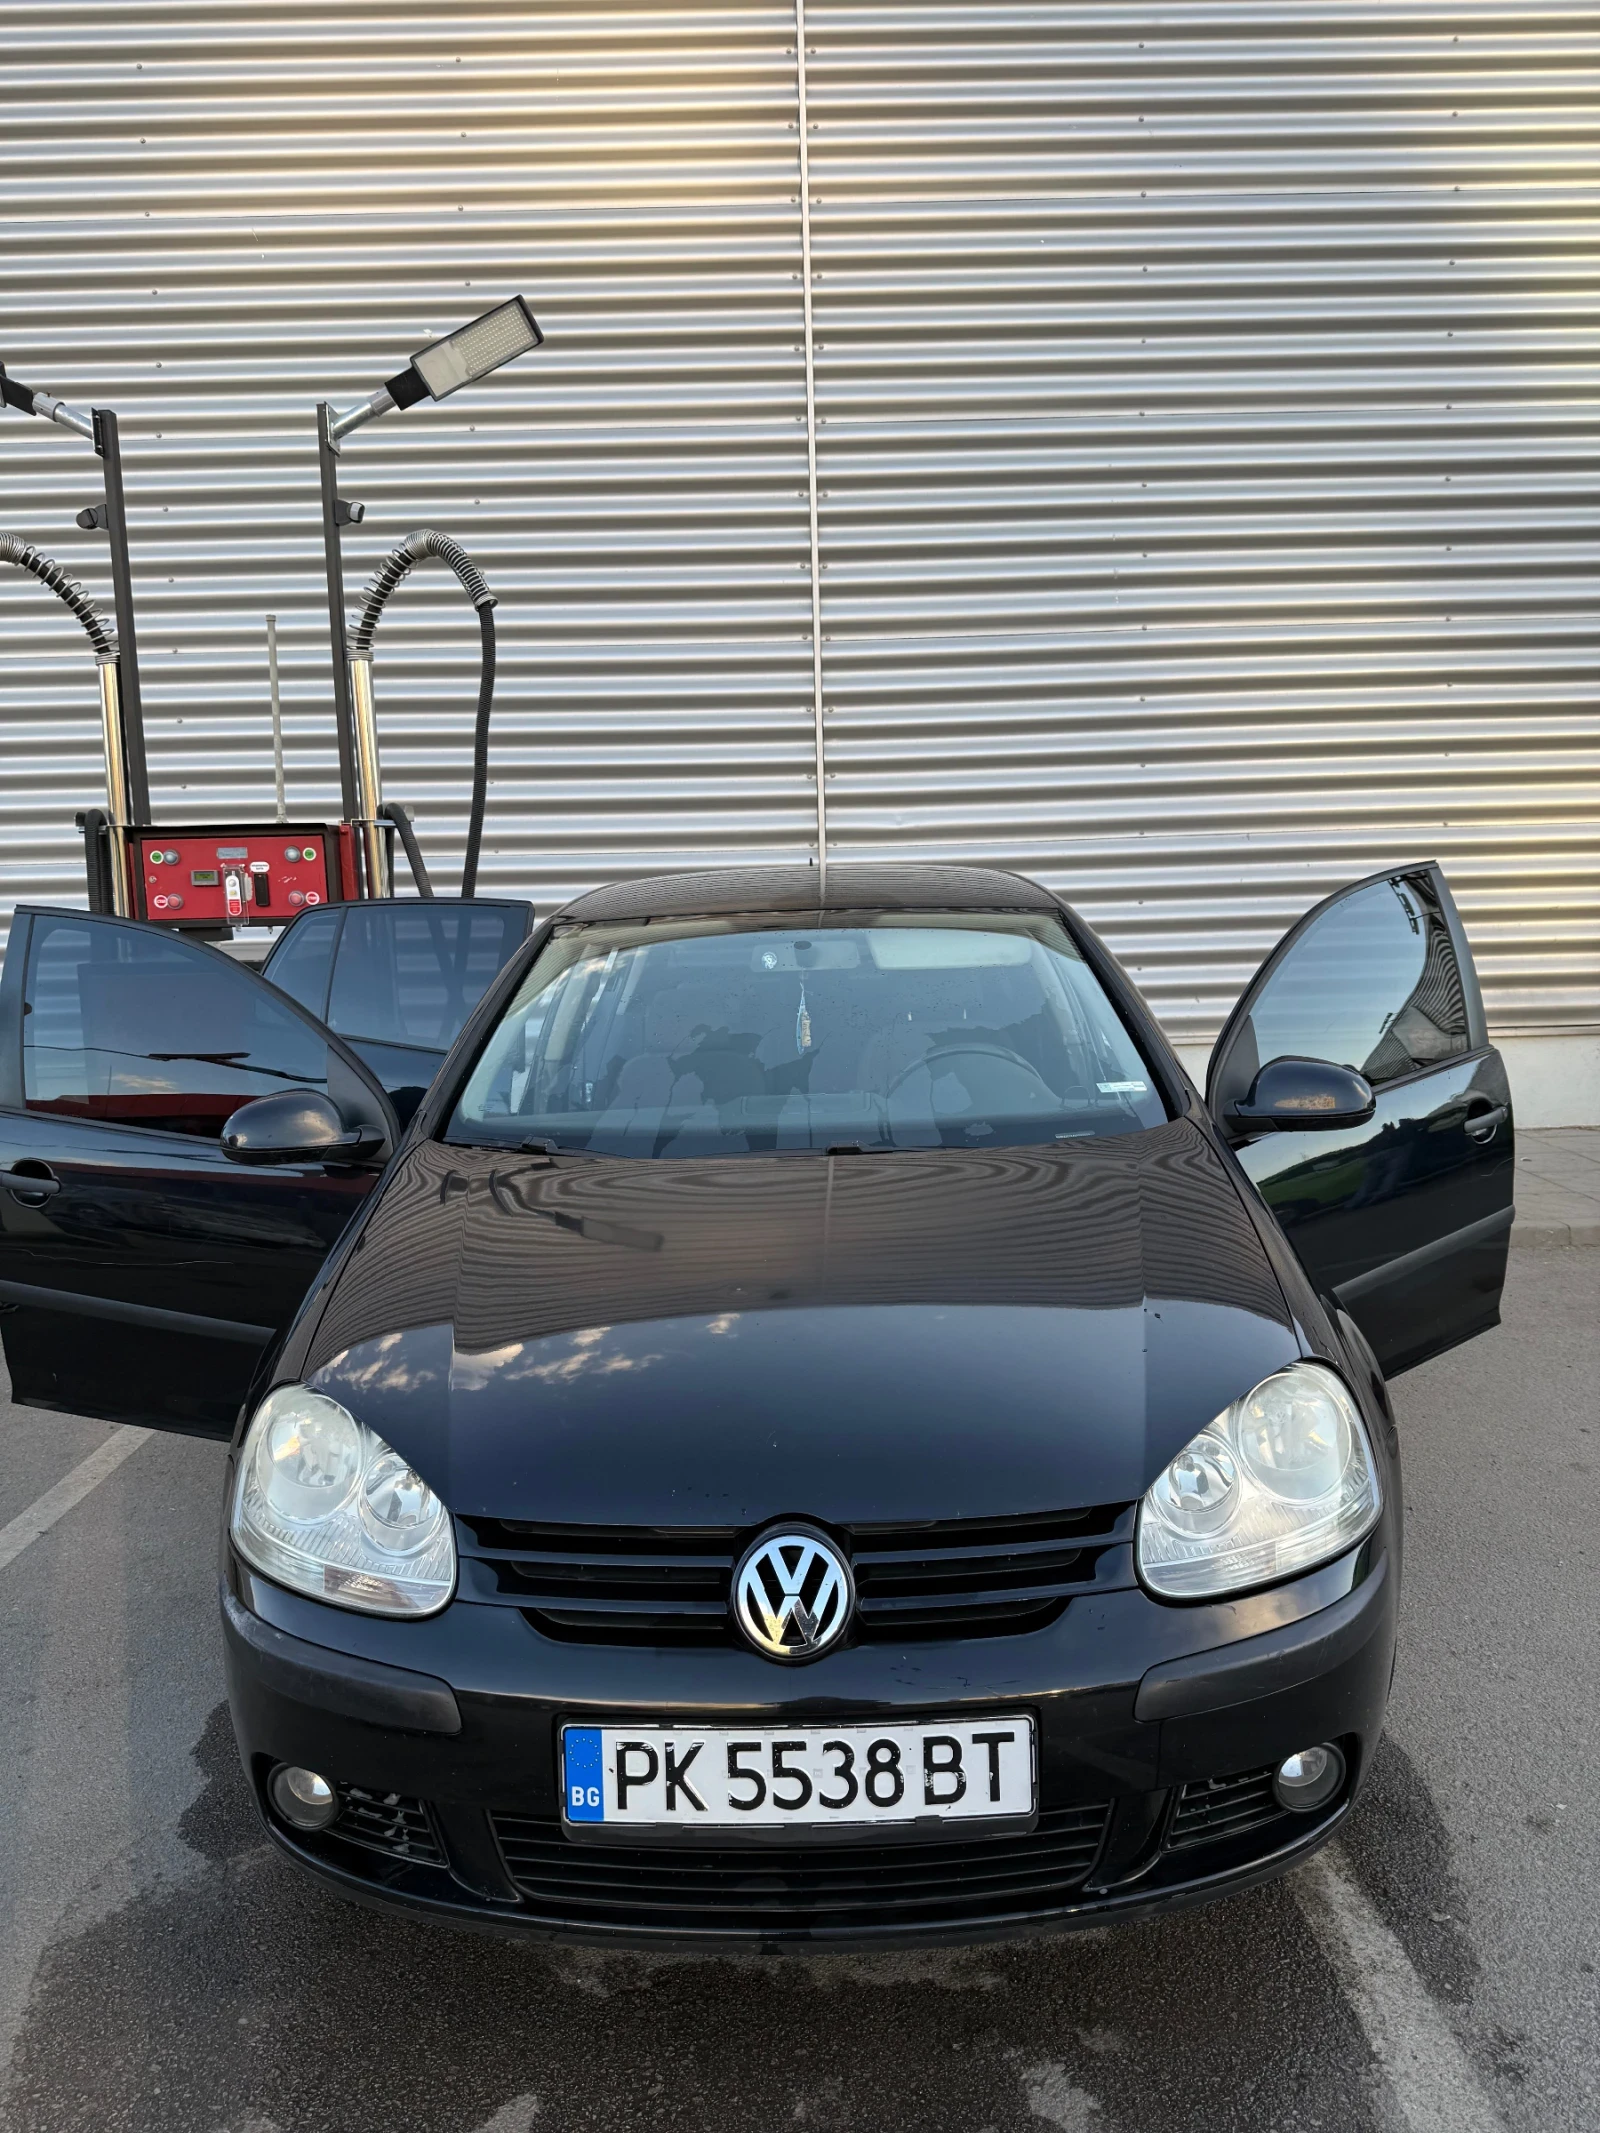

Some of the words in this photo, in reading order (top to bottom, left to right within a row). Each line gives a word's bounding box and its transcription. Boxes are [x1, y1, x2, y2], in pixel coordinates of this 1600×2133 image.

[738, 1535, 848, 1656] VW
[571, 1786, 600, 1807] BG
[615, 1741, 709, 1811] PK
[727, 1738, 905, 1811] 5538
[923, 1732, 1015, 1806] BT
